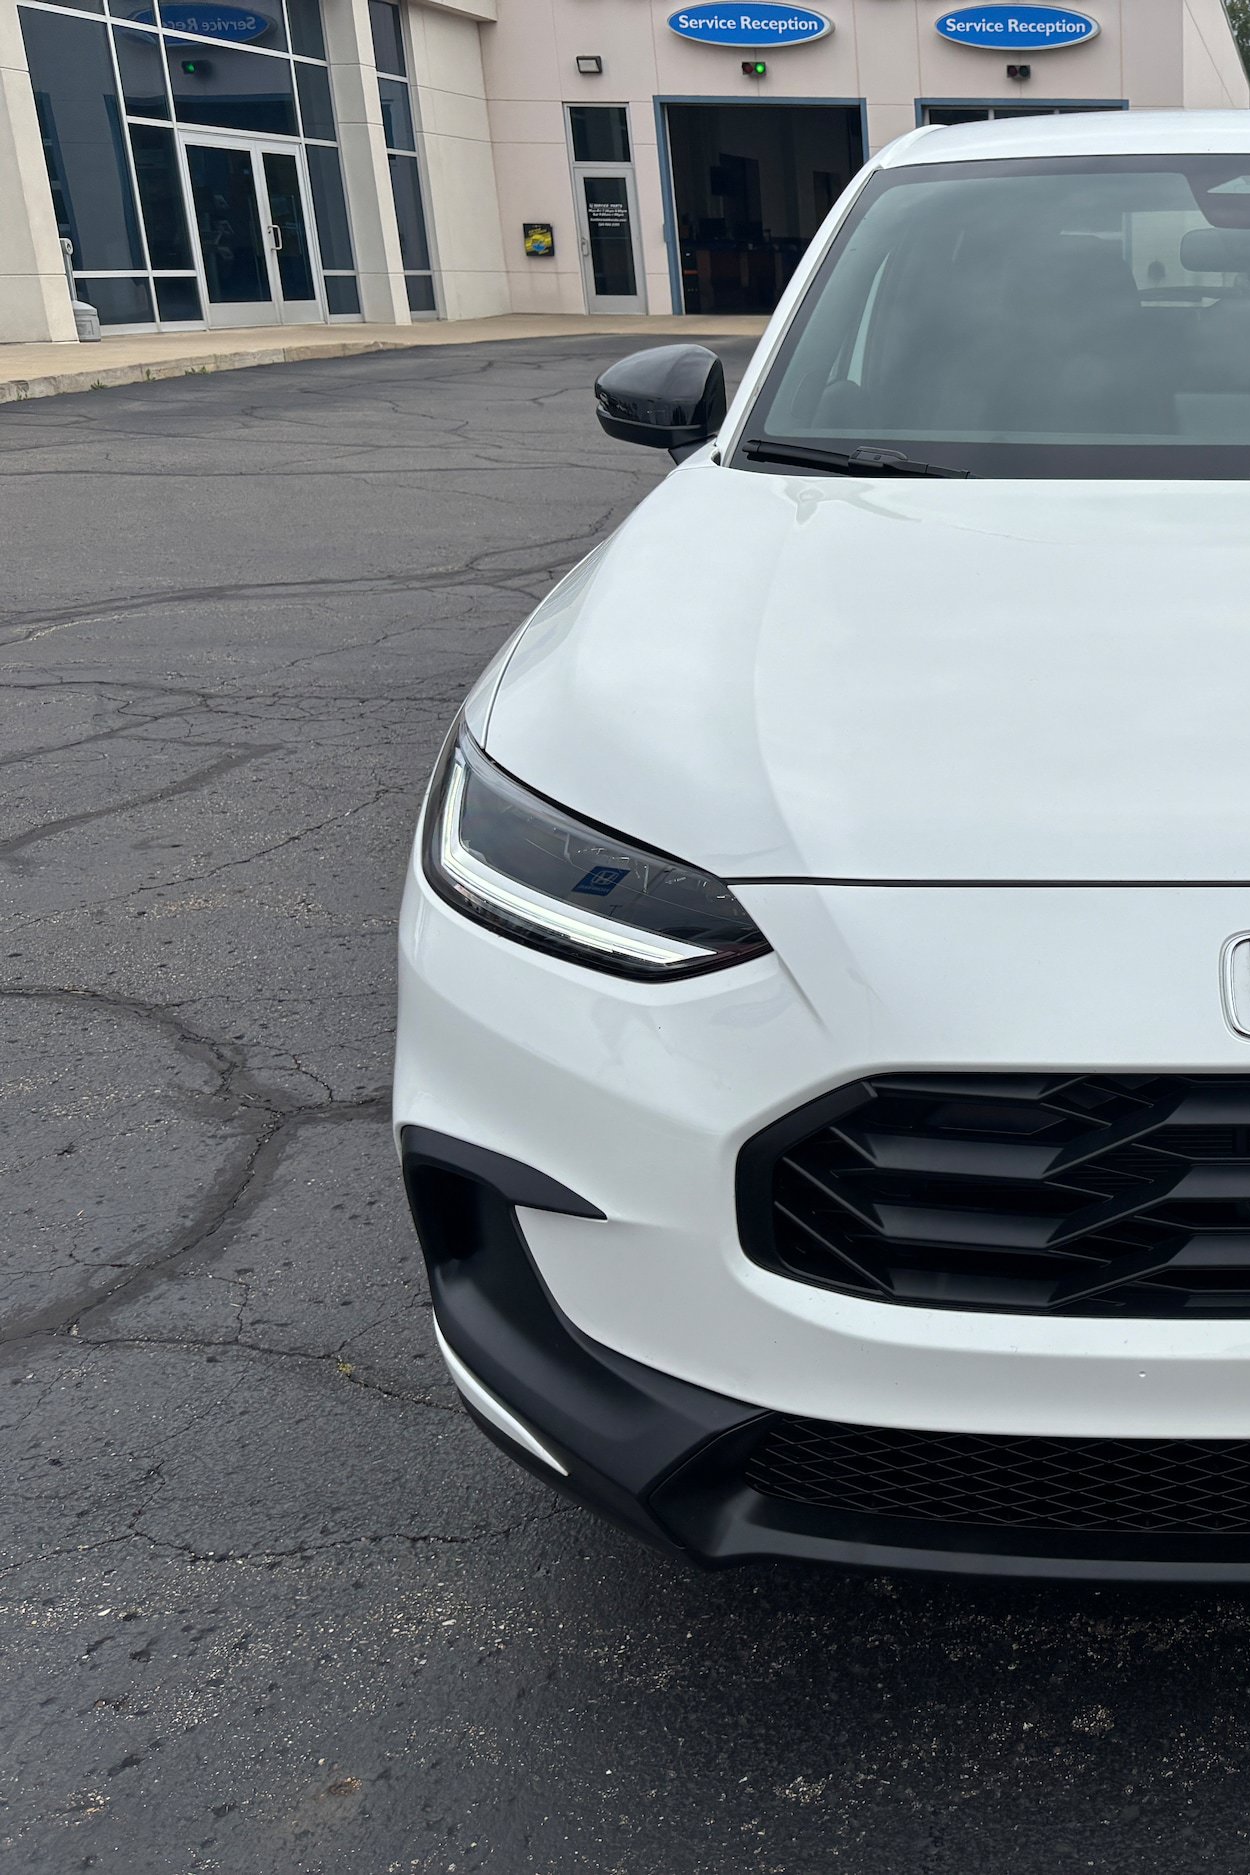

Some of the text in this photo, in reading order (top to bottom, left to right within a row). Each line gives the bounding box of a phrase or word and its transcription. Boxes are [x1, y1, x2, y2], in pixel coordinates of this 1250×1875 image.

[678, 15, 818, 34] Service Reception
[946, 18, 1086, 36] Service Reception
